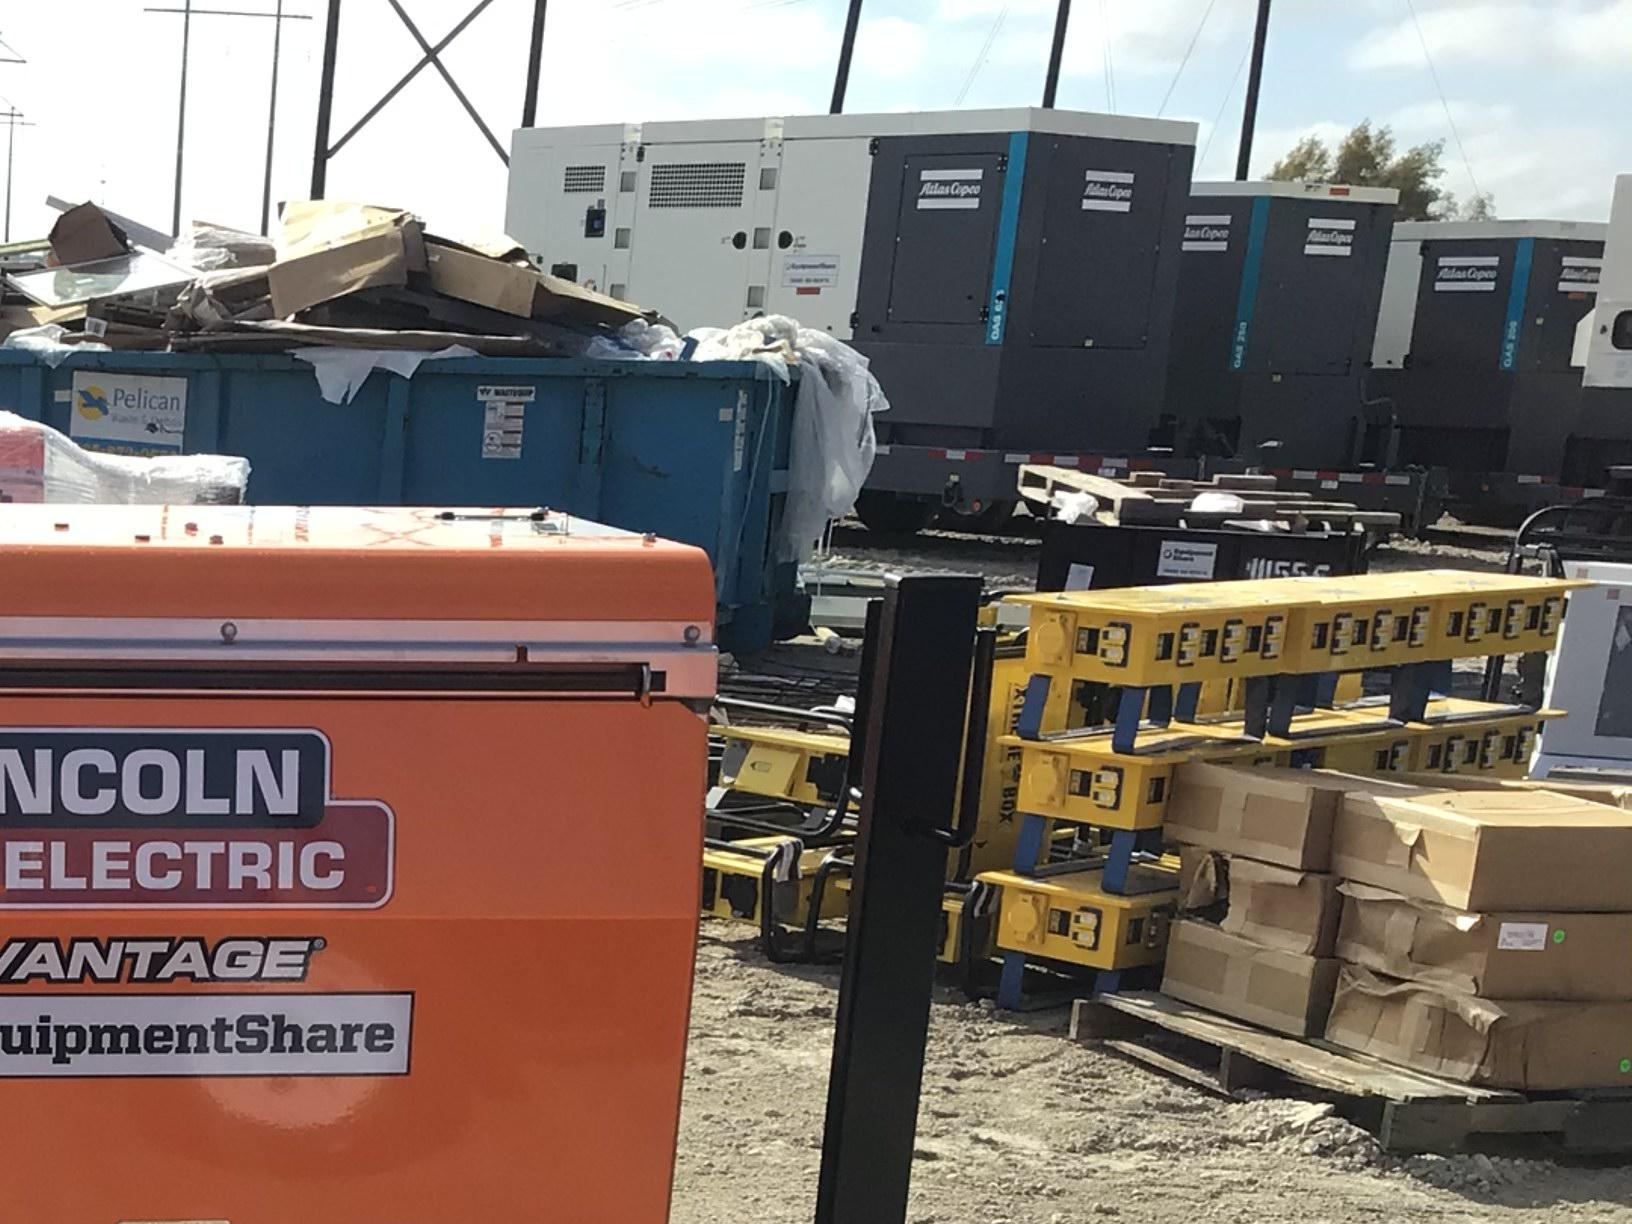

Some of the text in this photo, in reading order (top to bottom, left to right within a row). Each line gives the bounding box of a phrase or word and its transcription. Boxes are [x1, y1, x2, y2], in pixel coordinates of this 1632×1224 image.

[919, 181, 981, 196] Atlas Copco
[113, 388, 181, 410] Pelican
[999, 786, 1017, 824] BOX
[4, 841, 346, 890] ELECTRIC
